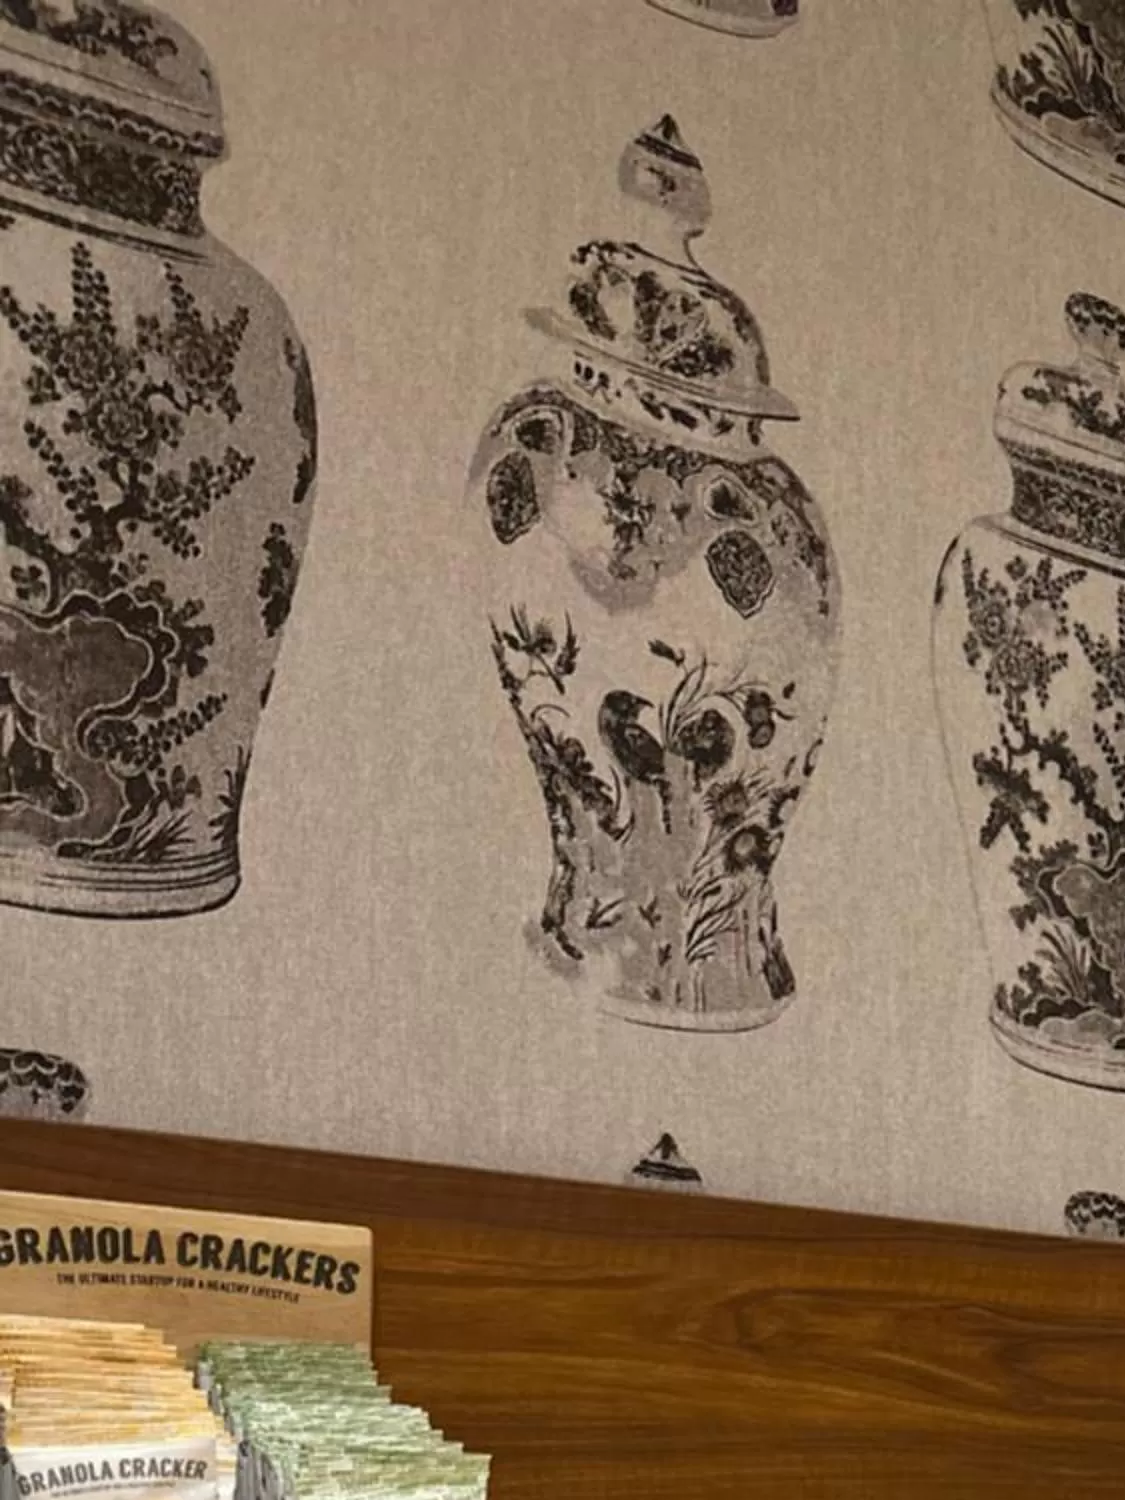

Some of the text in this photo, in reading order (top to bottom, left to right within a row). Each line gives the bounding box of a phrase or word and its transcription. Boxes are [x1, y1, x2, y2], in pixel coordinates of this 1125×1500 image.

[0, 1226, 361, 1294] GRANOLA CRACKERS
[57, 1272, 75, 1285] THE
[78, 1272, 127, 1286] ULTIMATE
[175, 1275, 195, 1289] FOR
[207, 1278, 249, 1295] HEALTHY
[251, 1285, 300, 1305] LIFESTYLE
[17, 1460, 114, 1496] GRANOLA
[118, 1456, 208, 1480] CRACKER
